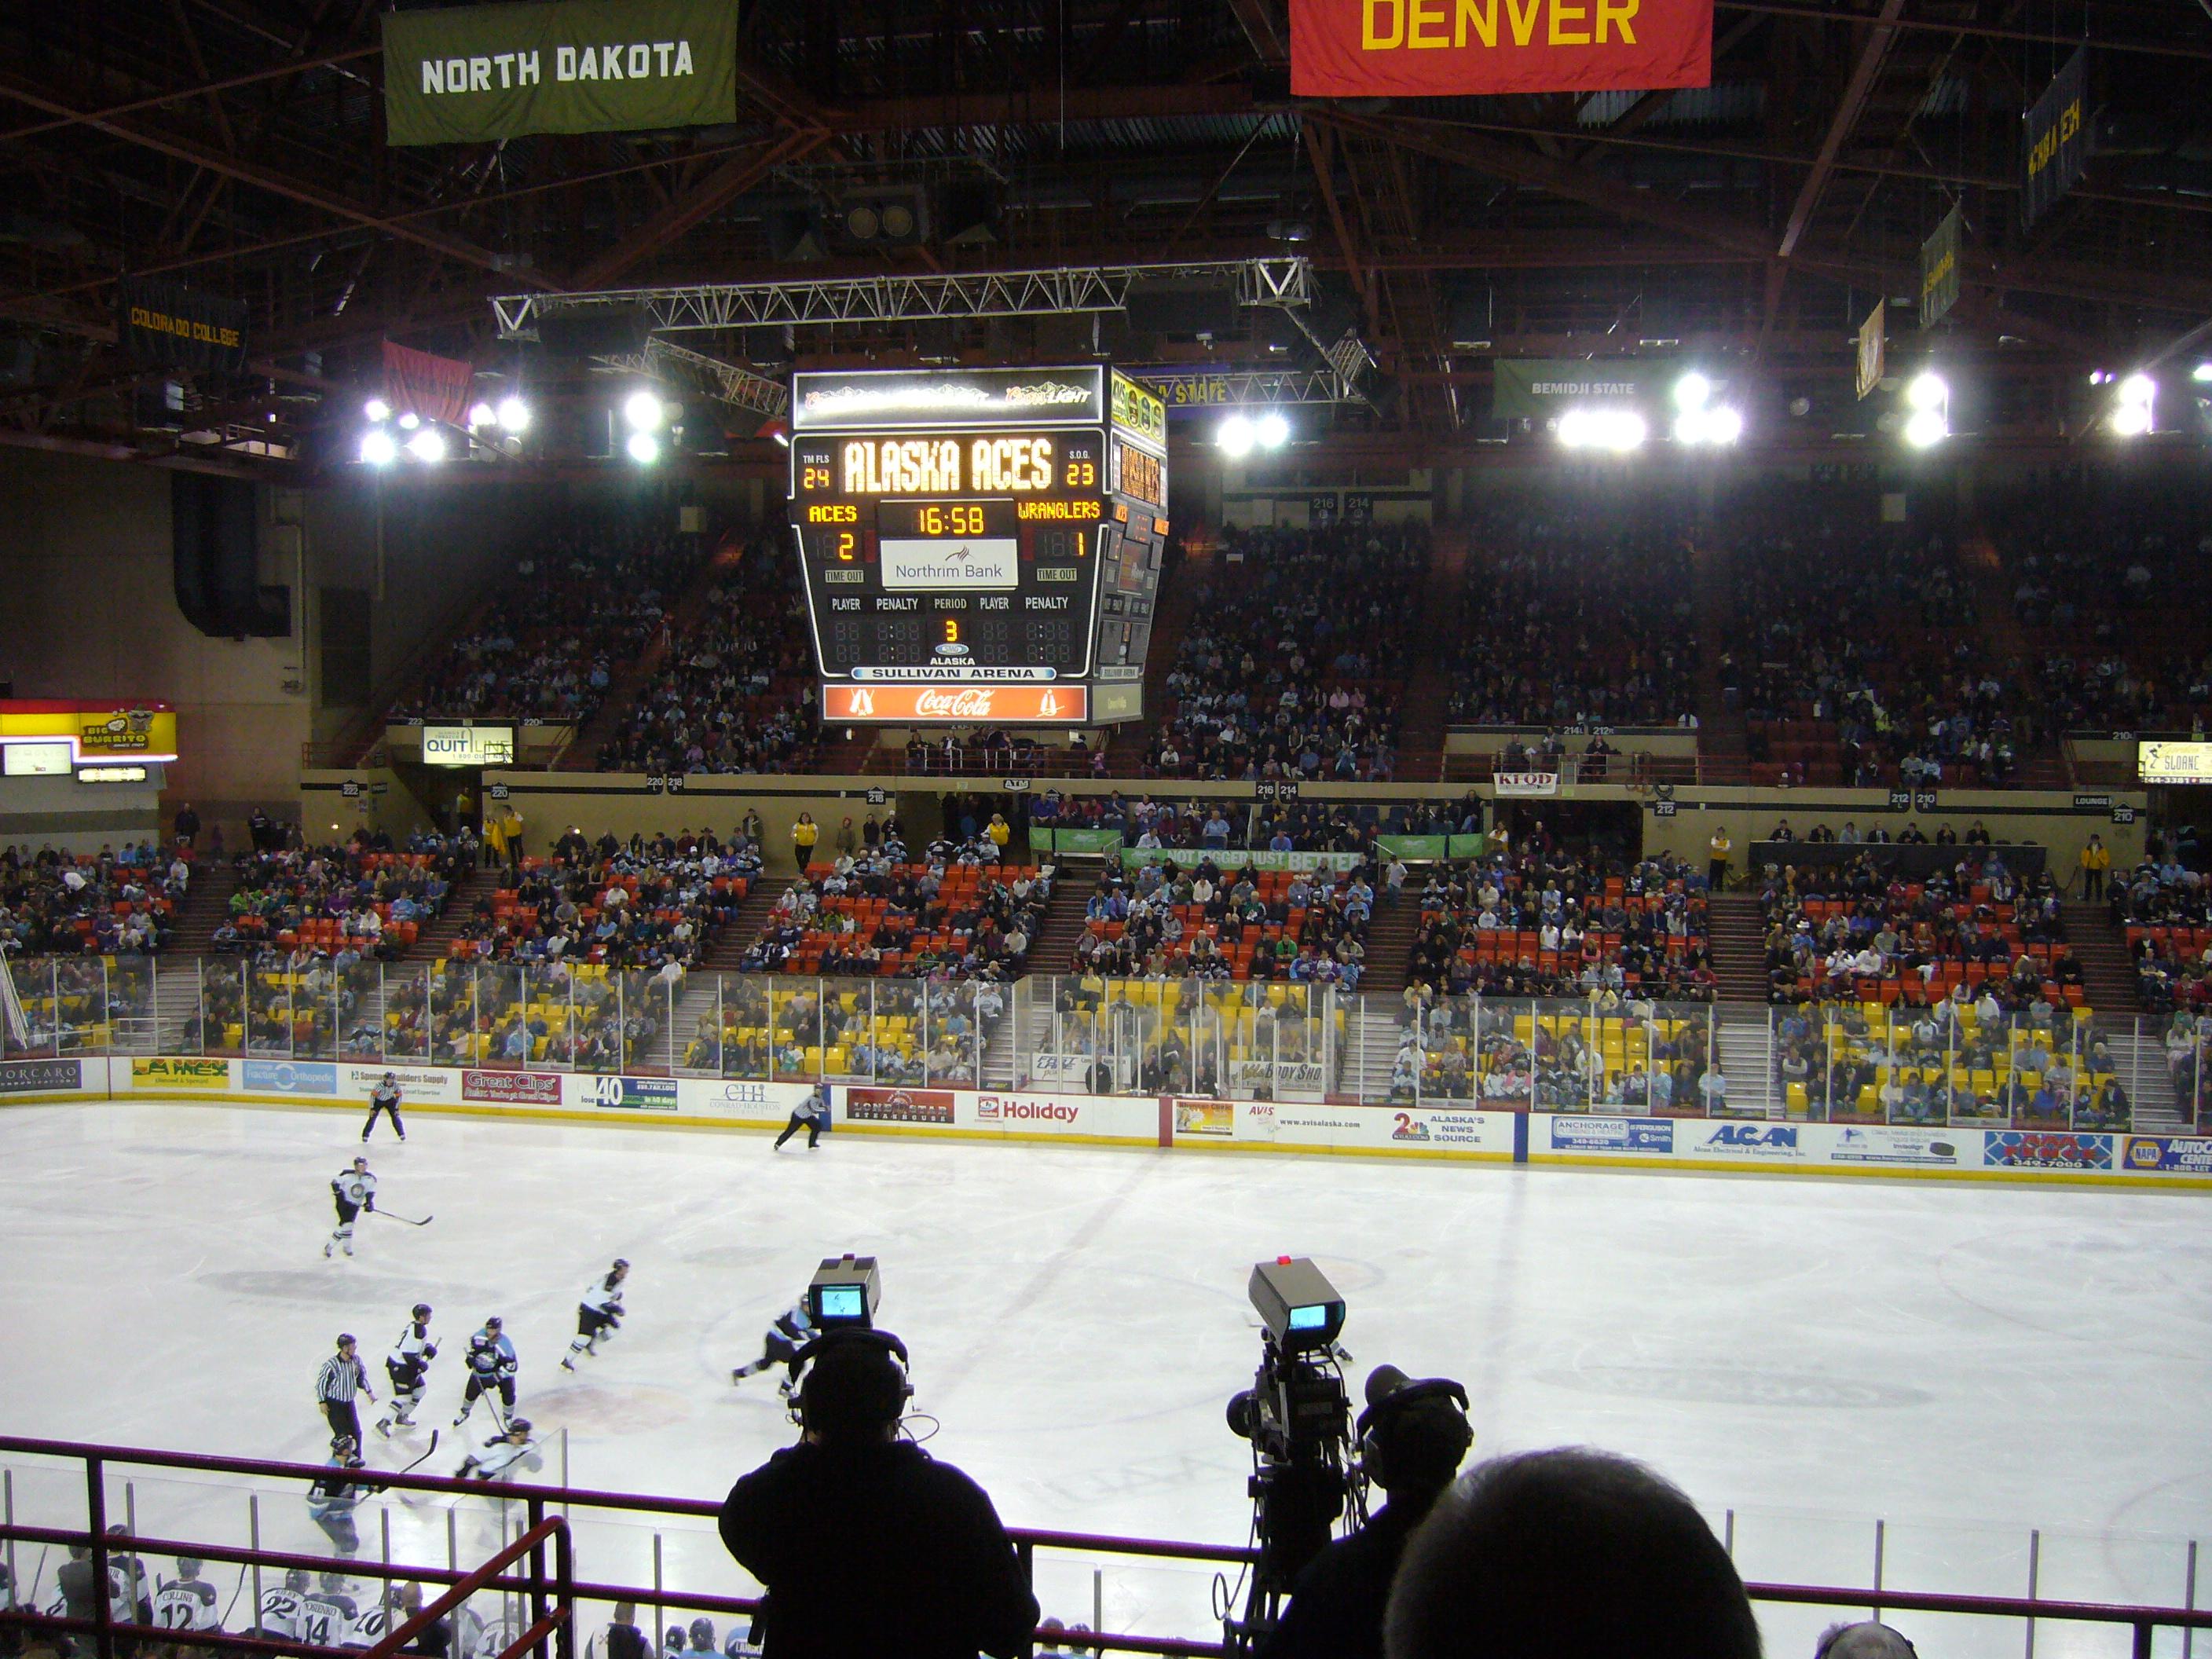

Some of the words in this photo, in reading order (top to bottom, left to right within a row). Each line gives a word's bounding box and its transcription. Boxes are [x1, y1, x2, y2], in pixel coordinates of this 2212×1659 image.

[1362, 0, 1639, 50] DENVER
[422, 50, 540, 94] NORTH
[557, 41, 694, 82] DAKOTA
[131, 306, 189, 338] COLORADO
[193, 321, 240, 347] COLLEGE
[1176, 382, 1226, 404] STATE
[1532, 383, 1589, 394] BEMIDJI
[1592, 383, 1635, 394] STATE
[1047, 390, 1092, 404] LIGHT
[803, 456, 815, 464] TM
[815, 455, 830, 463] FLS
[1069, 451, 1090, 460] S.O.G.
[844, 440, 961, 493] ALASKA
[971, 438, 1053, 492] ACES
[804, 468, 830, 489] 24
[1067, 464, 1094, 485] 23
[1313, 498, 1335, 509] 216
[1348, 497, 1369, 508] 214
[809, 505, 857, 522] ACES
[1018, 501, 1101, 520] WRANGLERS
[918, 507, 984, 534] 16:58
[826, 572, 844, 582] TIME
[846, 571, 863, 581] OUT
[895, 563, 961, 579] Northrim
[965, 562, 1002, 578] Bank
[1038, 569, 1056, 580] TIME
[1058, 569, 1076, 580] OUT
[832, 599, 860, 610] PLAYER
[876, 598, 918, 610] PENALTY
[934, 598, 967, 610] PERIOD
[980, 598, 1009, 610] PLAYER
[1025, 596, 1068, 610] PENALTY
[946, 621, 958, 642] 3
[930, 657, 976, 666] ALASKA
[873, 668, 961, 679] SULLIVAN
[970, 668, 1036, 679] ARENA
[83, 735, 146, 744] BURRITO
[427, 740, 468, 753] QUIT
[474, 740, 510, 753] LINE
[647, 777, 663, 786] 220
[668, 777, 683, 786] 218
[1258, 786, 1274, 794] 216
[1280, 786, 1297, 794] 214
[868, 794, 884, 803] 218
[1892, 793, 1909, 803] 212
[1917, 794, 1936, 803] 210
[1657, 805, 1674, 814] 212
[2114, 812, 2133, 822] 210
[1167, 849, 1195, 864] NOT
[1198, 850, 1248, 865] BIGGER
[1252, 851, 1285, 866] JUST
[1288, 852, 1360, 872] BETTER
[0, 1067, 76, 1081] ORCARO
[132, 1059, 170, 1075] LA
[174, 1059, 229, 1077] MEX
[1298, 1064, 1323, 1081] SHO
[247, 1068, 279, 1080] Fracture
[290, 1071, 334, 1083] Orthopedic
[360, 1071, 384, 1081] Spena
[396, 1073, 422, 1082] uilders
[423, 1074, 449, 1085] Supply
[467, 1071, 513, 1089] Great
[515, 1074, 555, 1092] Clips
[581, 1095, 595, 1104] lose
[596, 1077, 624, 1105] 40
[909, 1104, 948, 1115] STAR
[1003, 1101, 1079, 1123] Holiday
[1249, 1105, 1274, 1115] AVIS
[1280, 1119, 1361, 1128] www.avisalaska.com
[1393, 1112, 1410, 1134] 2
[1430, 1115, 1485, 1124] ALASKA'S
[1558, 1121, 1624, 1130] ANCHORAGE
[1441, 1125, 1474, 1133] NEWS
[1434, 1133, 1481, 1143] SOURCE
[1650, 1133, 1671, 1142] Smith
[1707, 1125, 1798, 1148] ALCAN
[2135, 1148, 2157, 1160] NAPA
[2013, 1159, 2083, 1168] 349-7000
[162, 1589, 194, 1602] COLLINS
[262, 1595, 298, 1620] 22
[161, 1603, 194, 1629] 12
[305, 1614, 330, 1646] 14
